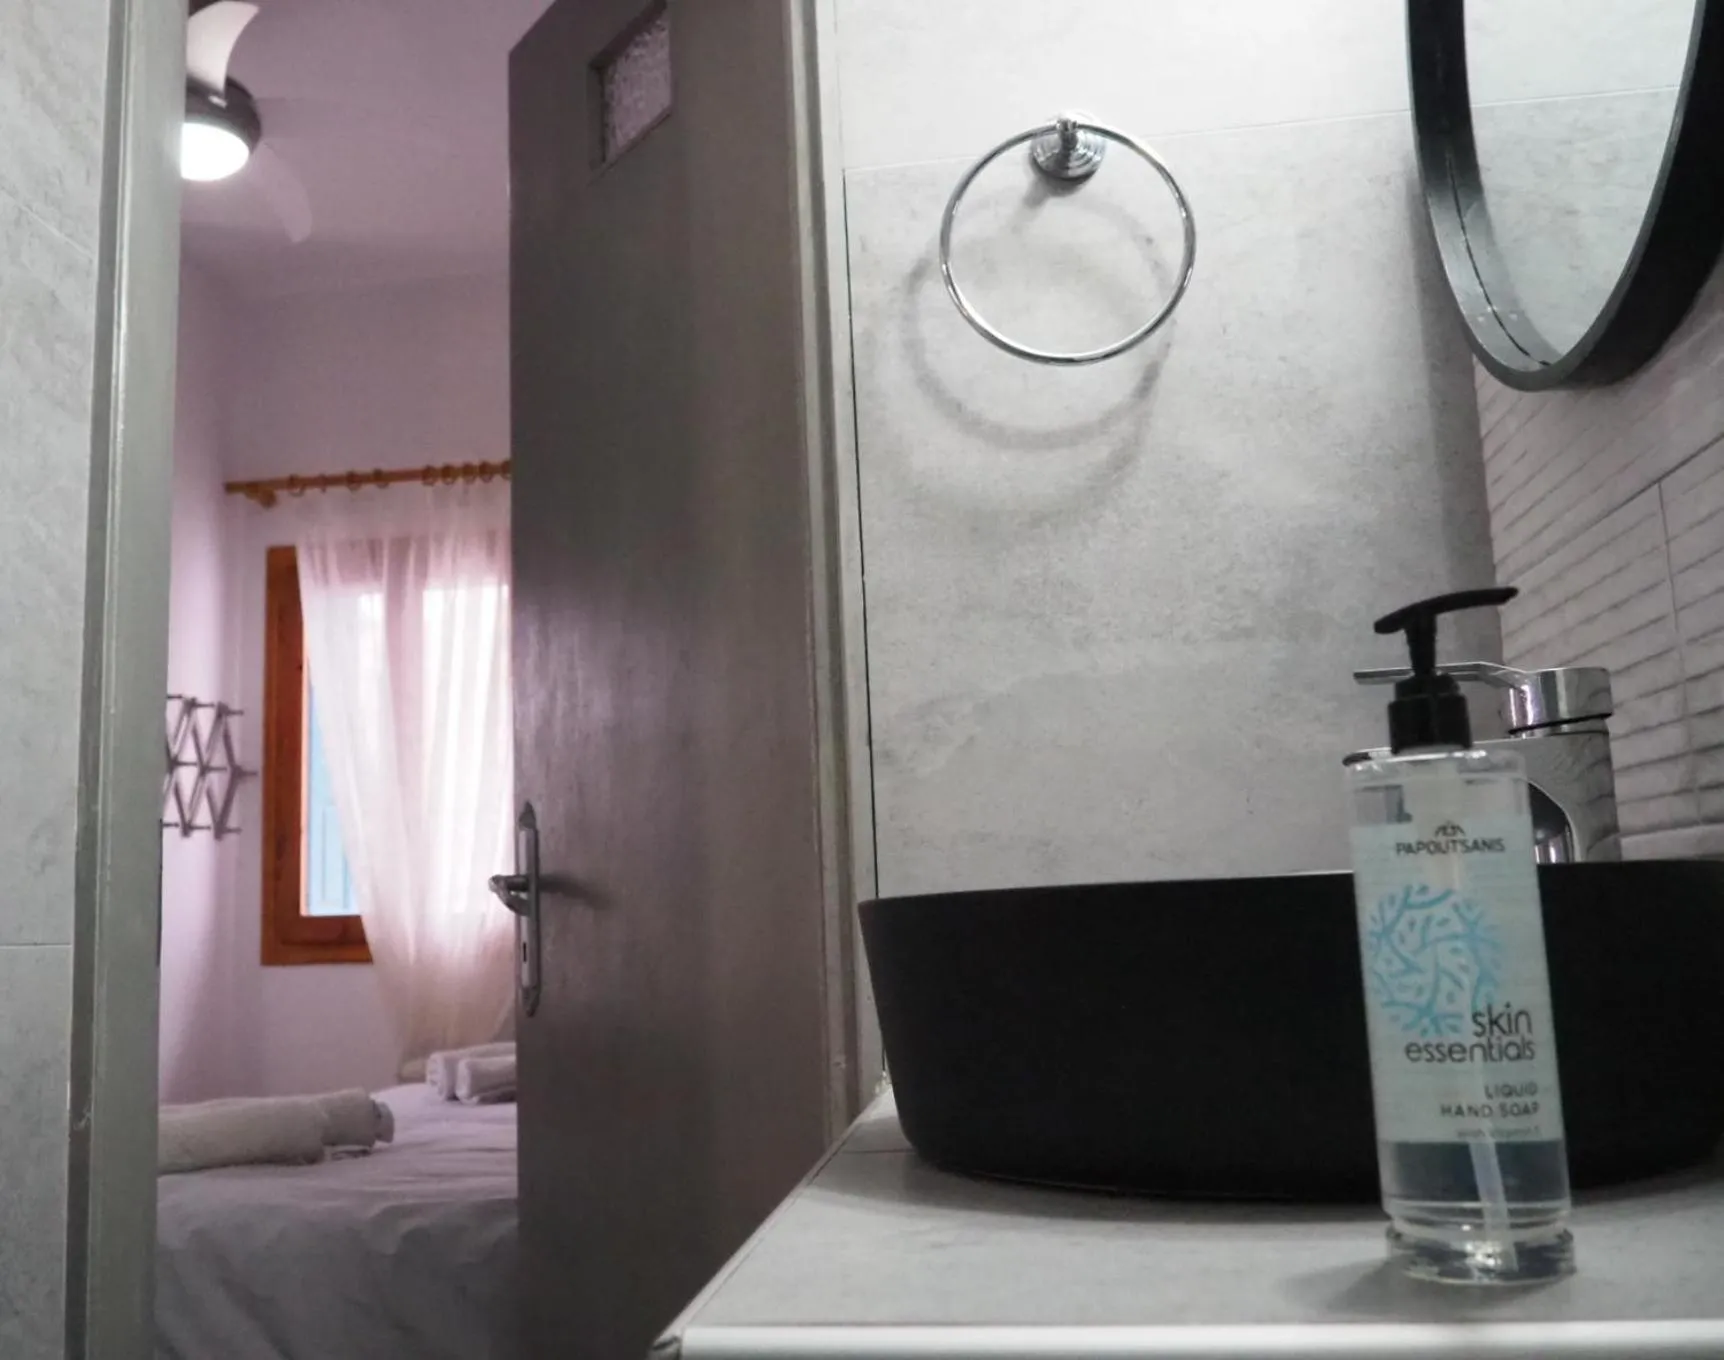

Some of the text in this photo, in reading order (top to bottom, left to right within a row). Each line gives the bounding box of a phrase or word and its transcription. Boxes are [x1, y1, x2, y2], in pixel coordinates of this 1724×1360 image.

[1396, 838, 1505, 855] PAPOUTSANIS
[1472, 1002, 1533, 1037] skin
[1405, 1036, 1535, 1063] essentials
[1484, 1082, 1538, 1099] LIQUID
[1440, 1102, 1539, 1118] HAND SOAP
